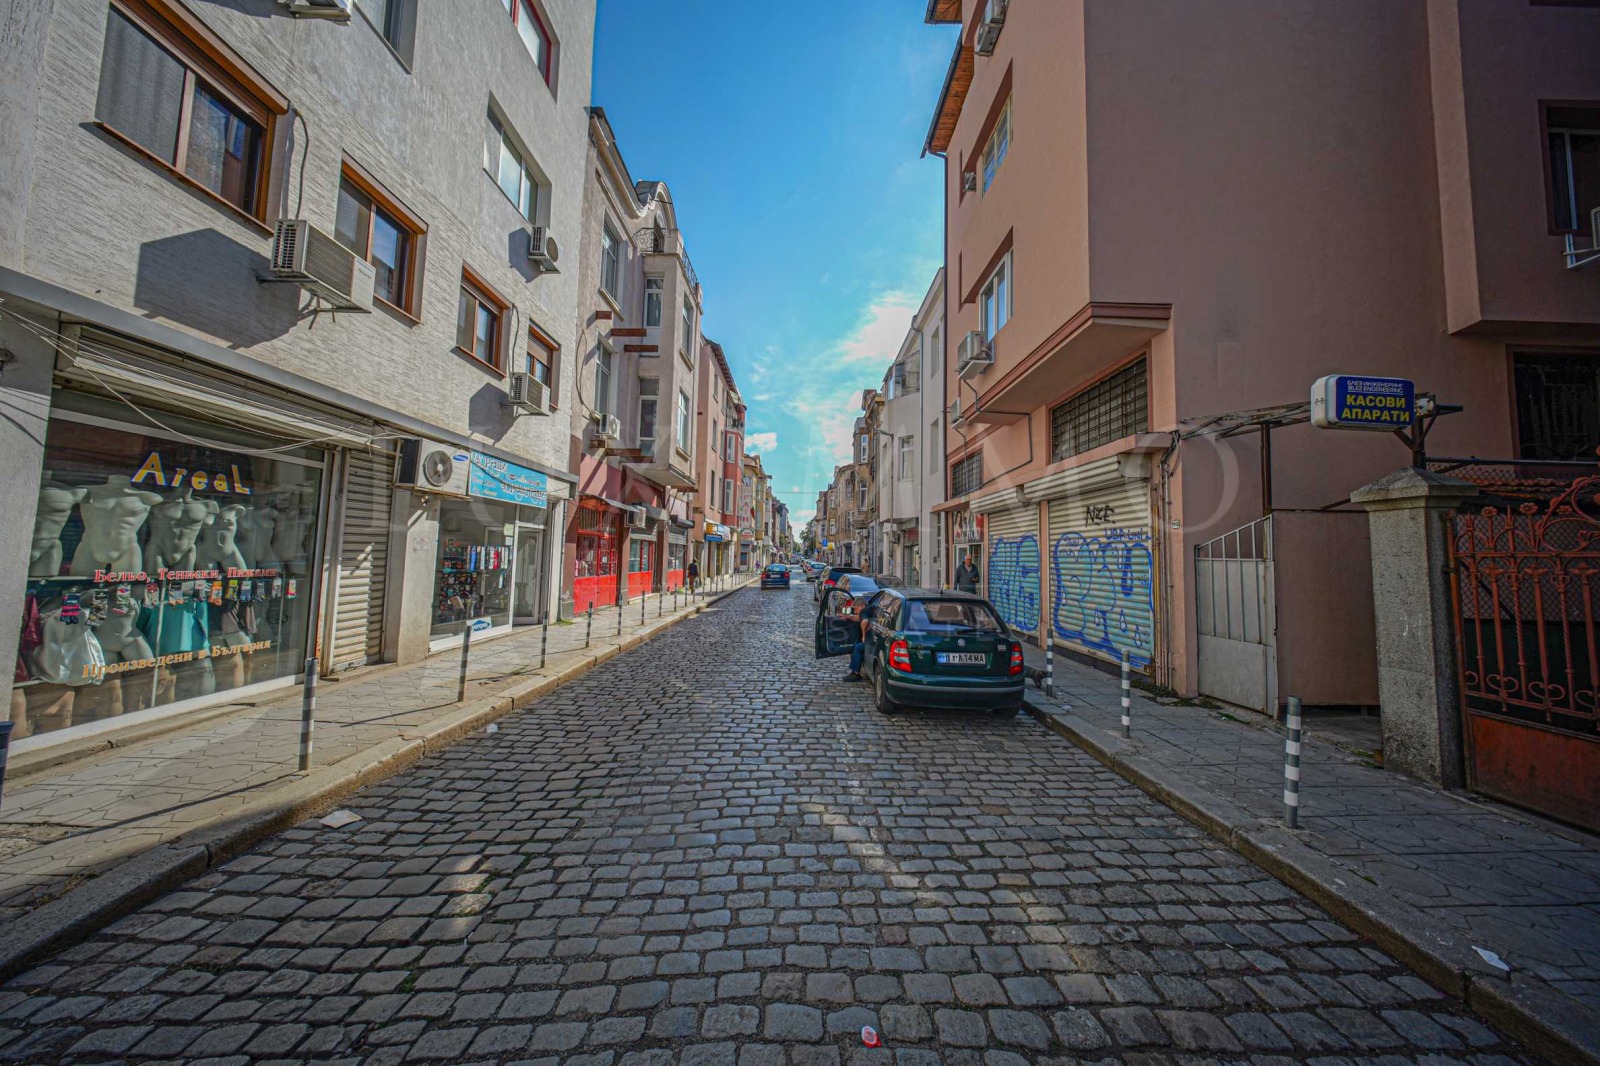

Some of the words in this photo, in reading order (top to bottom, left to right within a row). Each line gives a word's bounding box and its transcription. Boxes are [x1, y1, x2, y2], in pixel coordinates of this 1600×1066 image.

[1346, 394, 1406, 408] КАСОВИ
[1341, 407, 1410, 422] АПАРАТИ
[94, 569, 150, 583] Бельо,
[157, 567, 222, 580] Тениски,
[82, 651, 193, 680] Произведени
[198, 650, 206, 659] в
[211, 640, 271, 657] България
